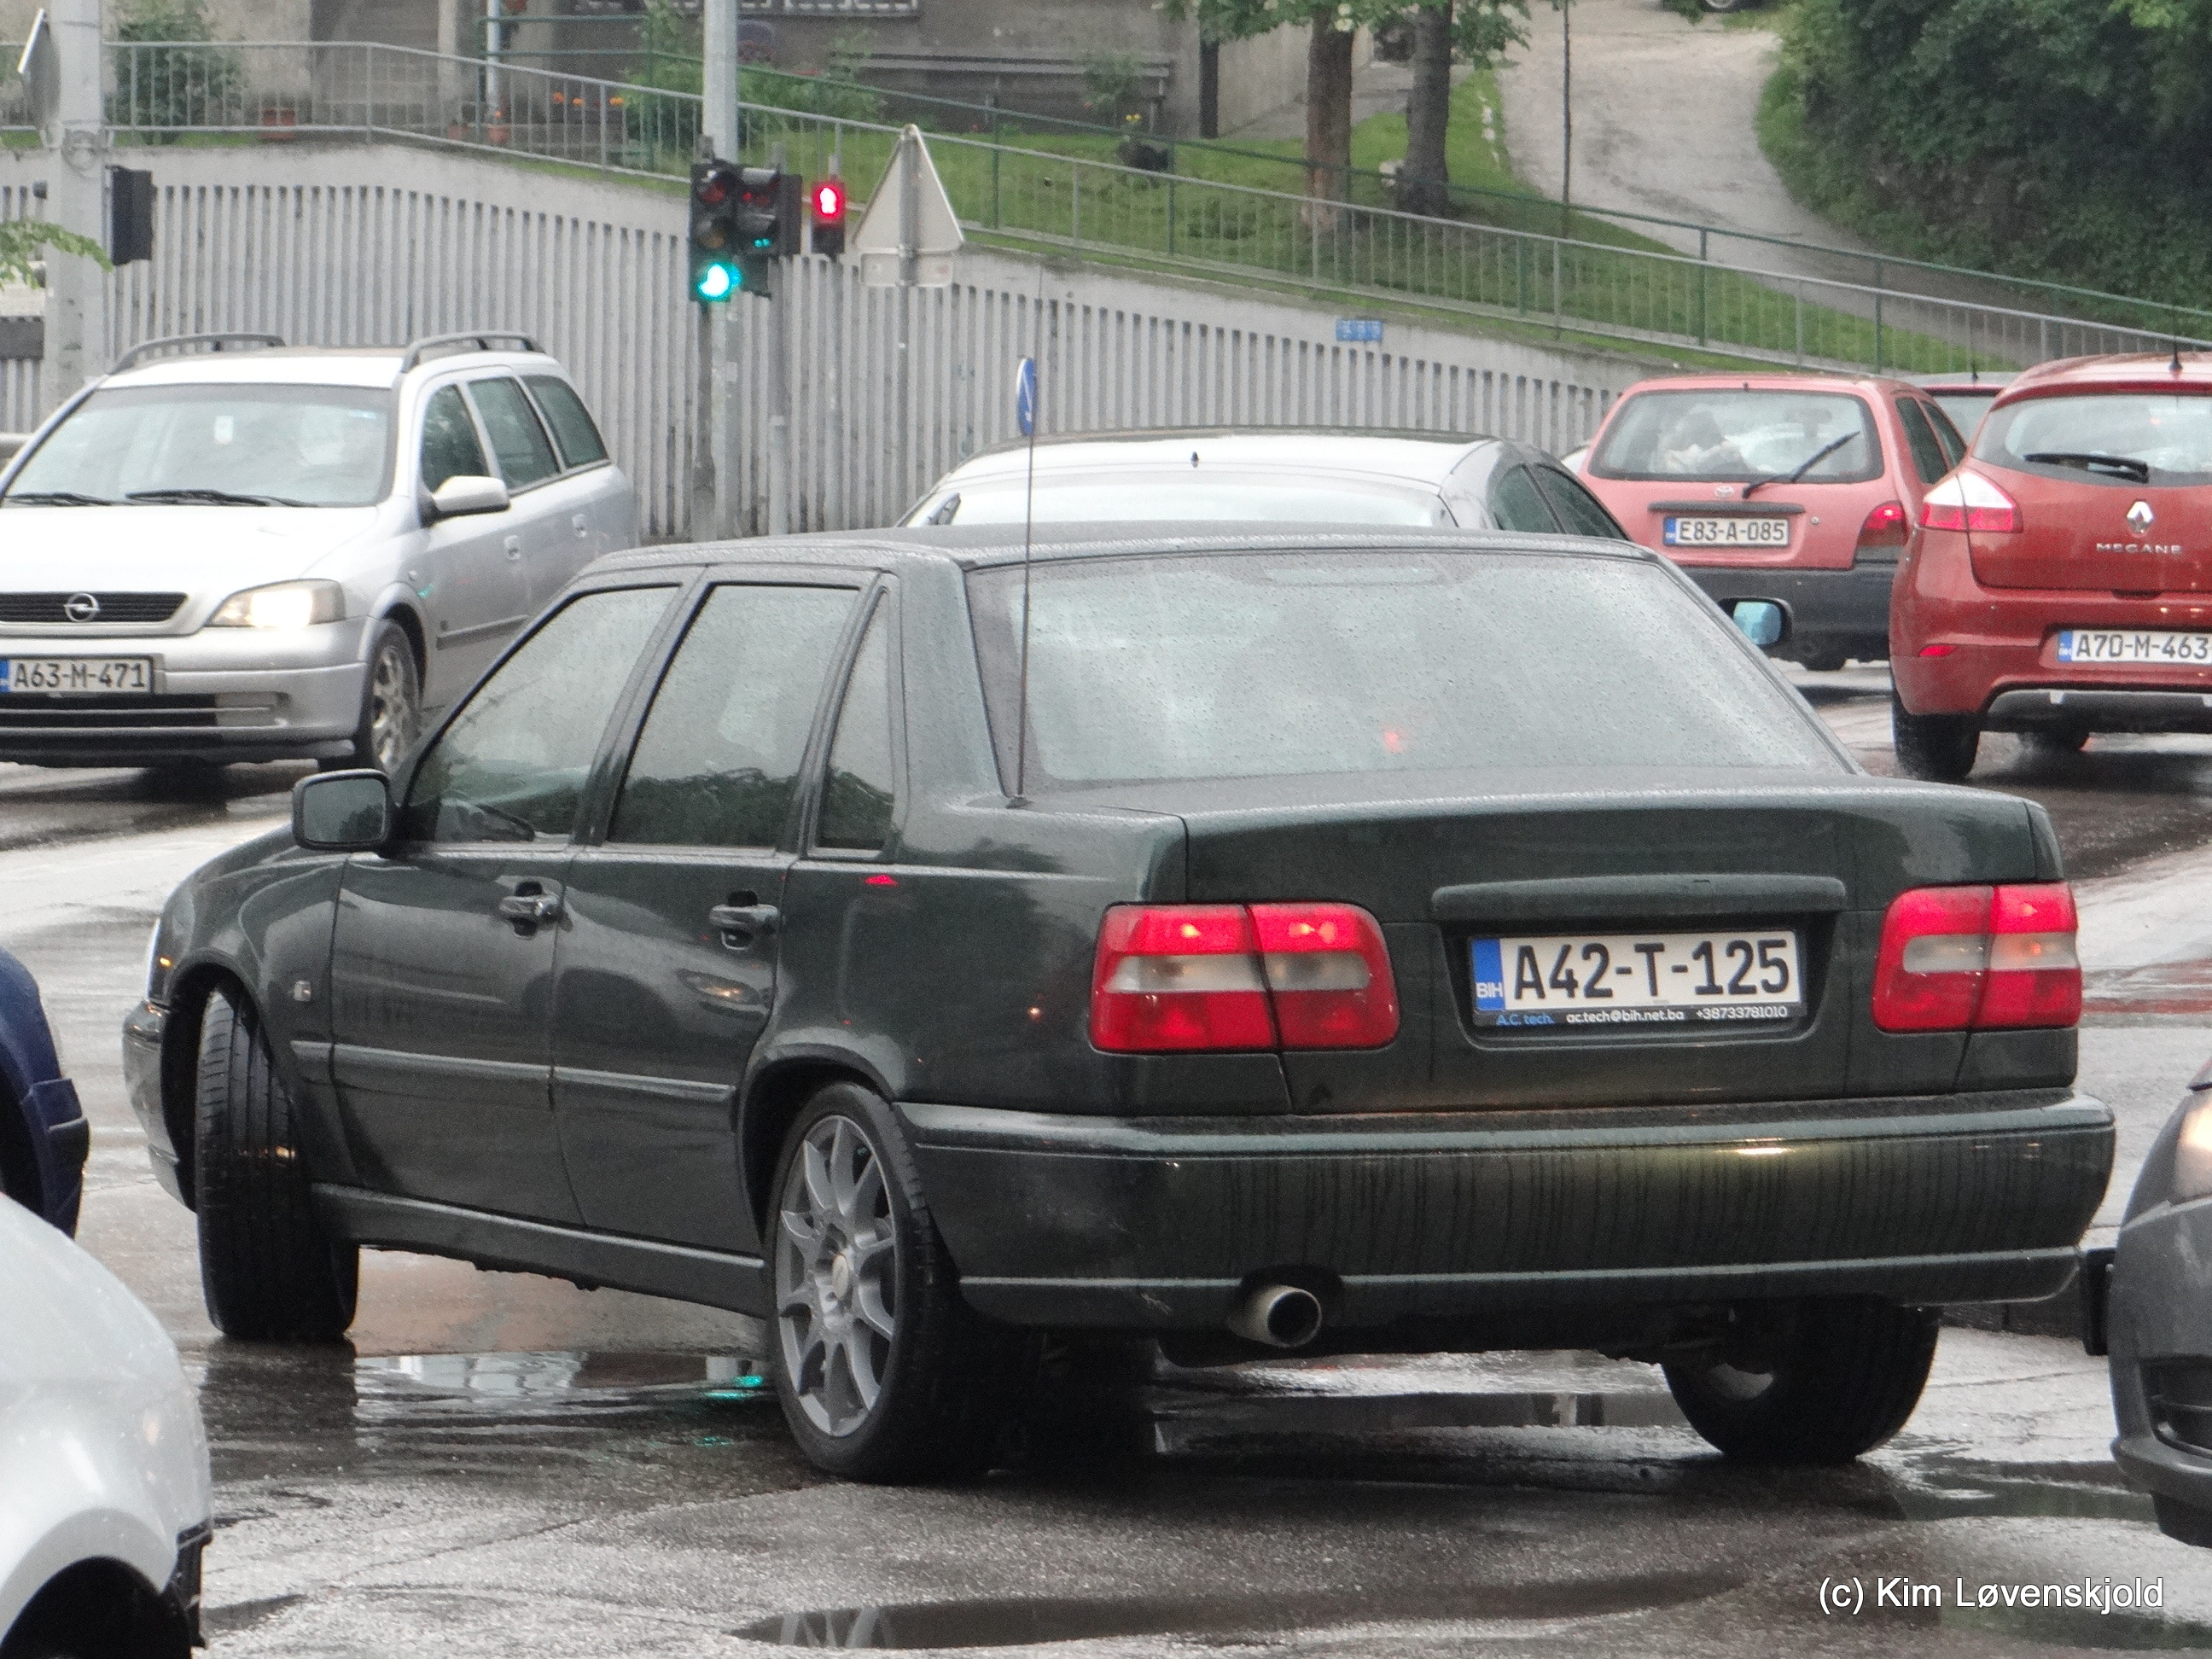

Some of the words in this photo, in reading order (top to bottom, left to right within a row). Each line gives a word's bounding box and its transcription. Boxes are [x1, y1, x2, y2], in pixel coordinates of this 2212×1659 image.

[1679, 521, 1785, 542] E83-A-085
[2096, 542, 2182, 554] MEGANE
[2075, 634, 2209, 659] A70-M-463
[14, 662, 145, 689] A63-M-471
[1513, 939, 1790, 1000] A42-T-125
[1476, 981, 1504, 998] BIH
